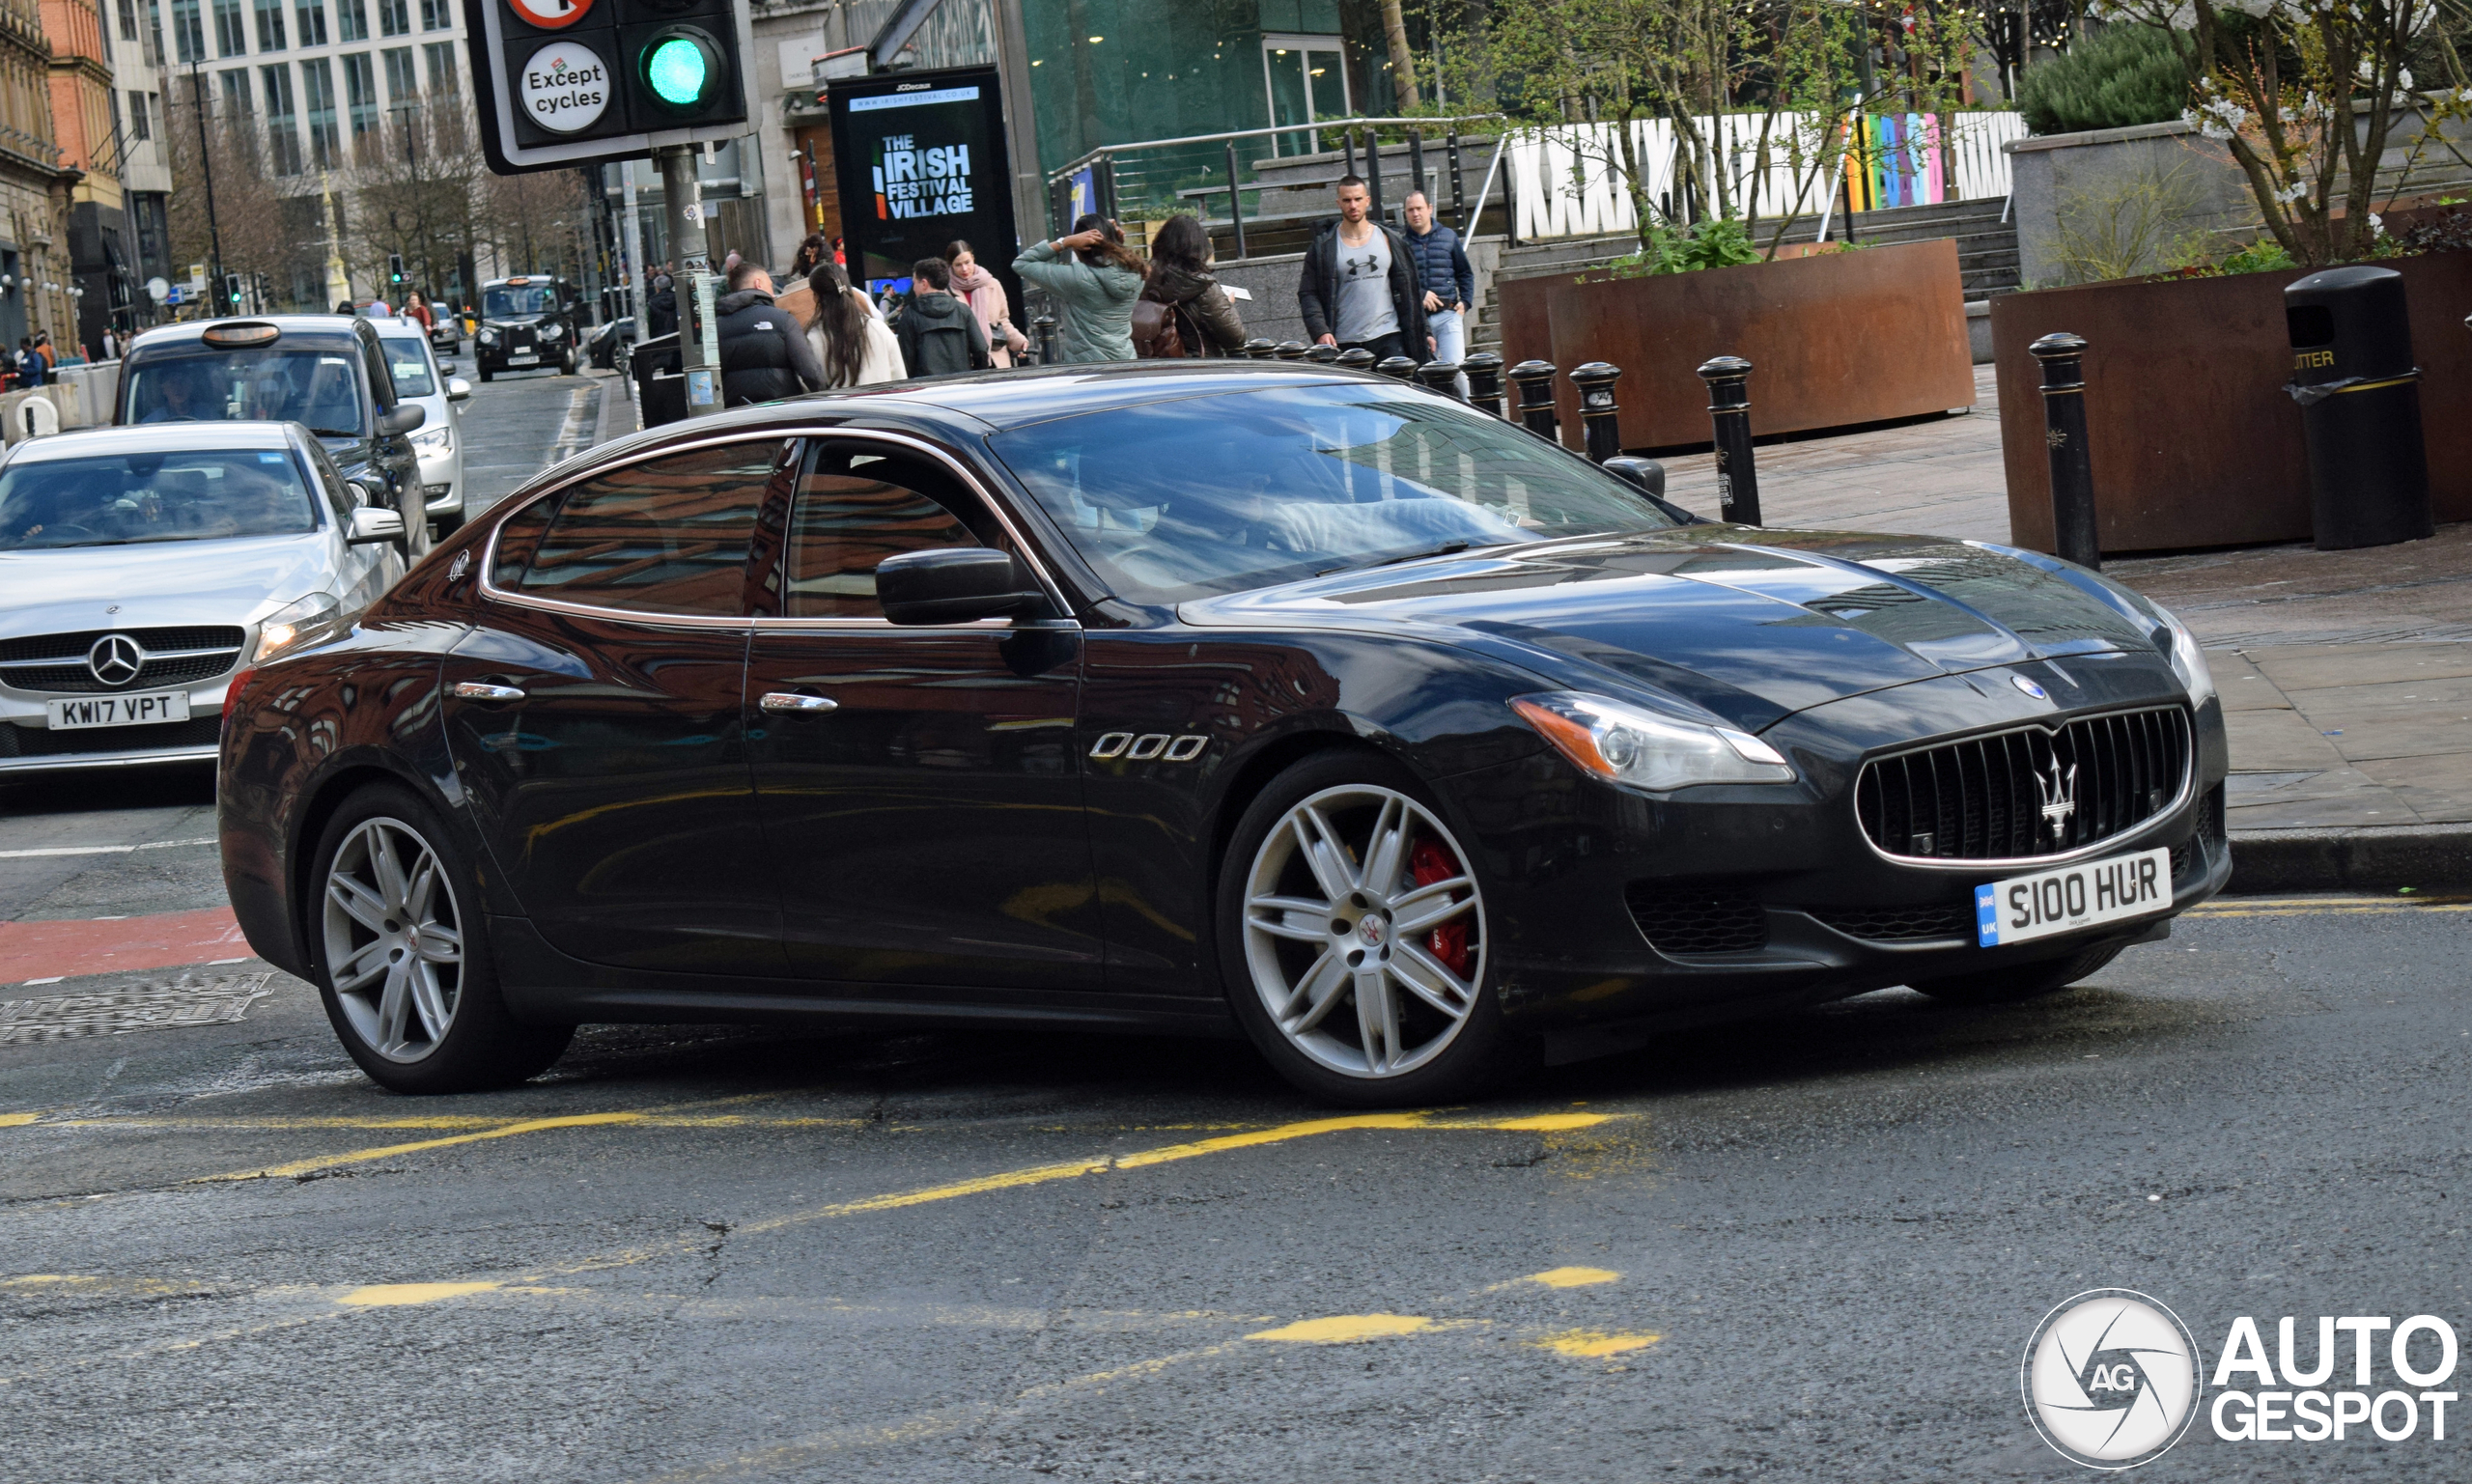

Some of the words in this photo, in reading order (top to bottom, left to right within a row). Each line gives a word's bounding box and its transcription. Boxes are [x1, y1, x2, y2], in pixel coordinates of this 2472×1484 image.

[529, 65, 602, 90] Except
[896, 83, 931, 92] JCDecaux
[536, 91, 602, 114] cycles
[882, 134, 914, 152] THE
[884, 144, 970, 183] IRISH
[886, 177, 972, 201] FESTIVAL
[888, 193, 974, 219] VILLAGE
[2294, 350, 2335, 369] ITTER
[63, 700, 115, 724] KW17
[124, 696, 170, 720] VPT
[2008, 872, 2086, 929] S100
[2095, 856, 2158, 911] HUR
[1981, 922, 1997, 935] UK
